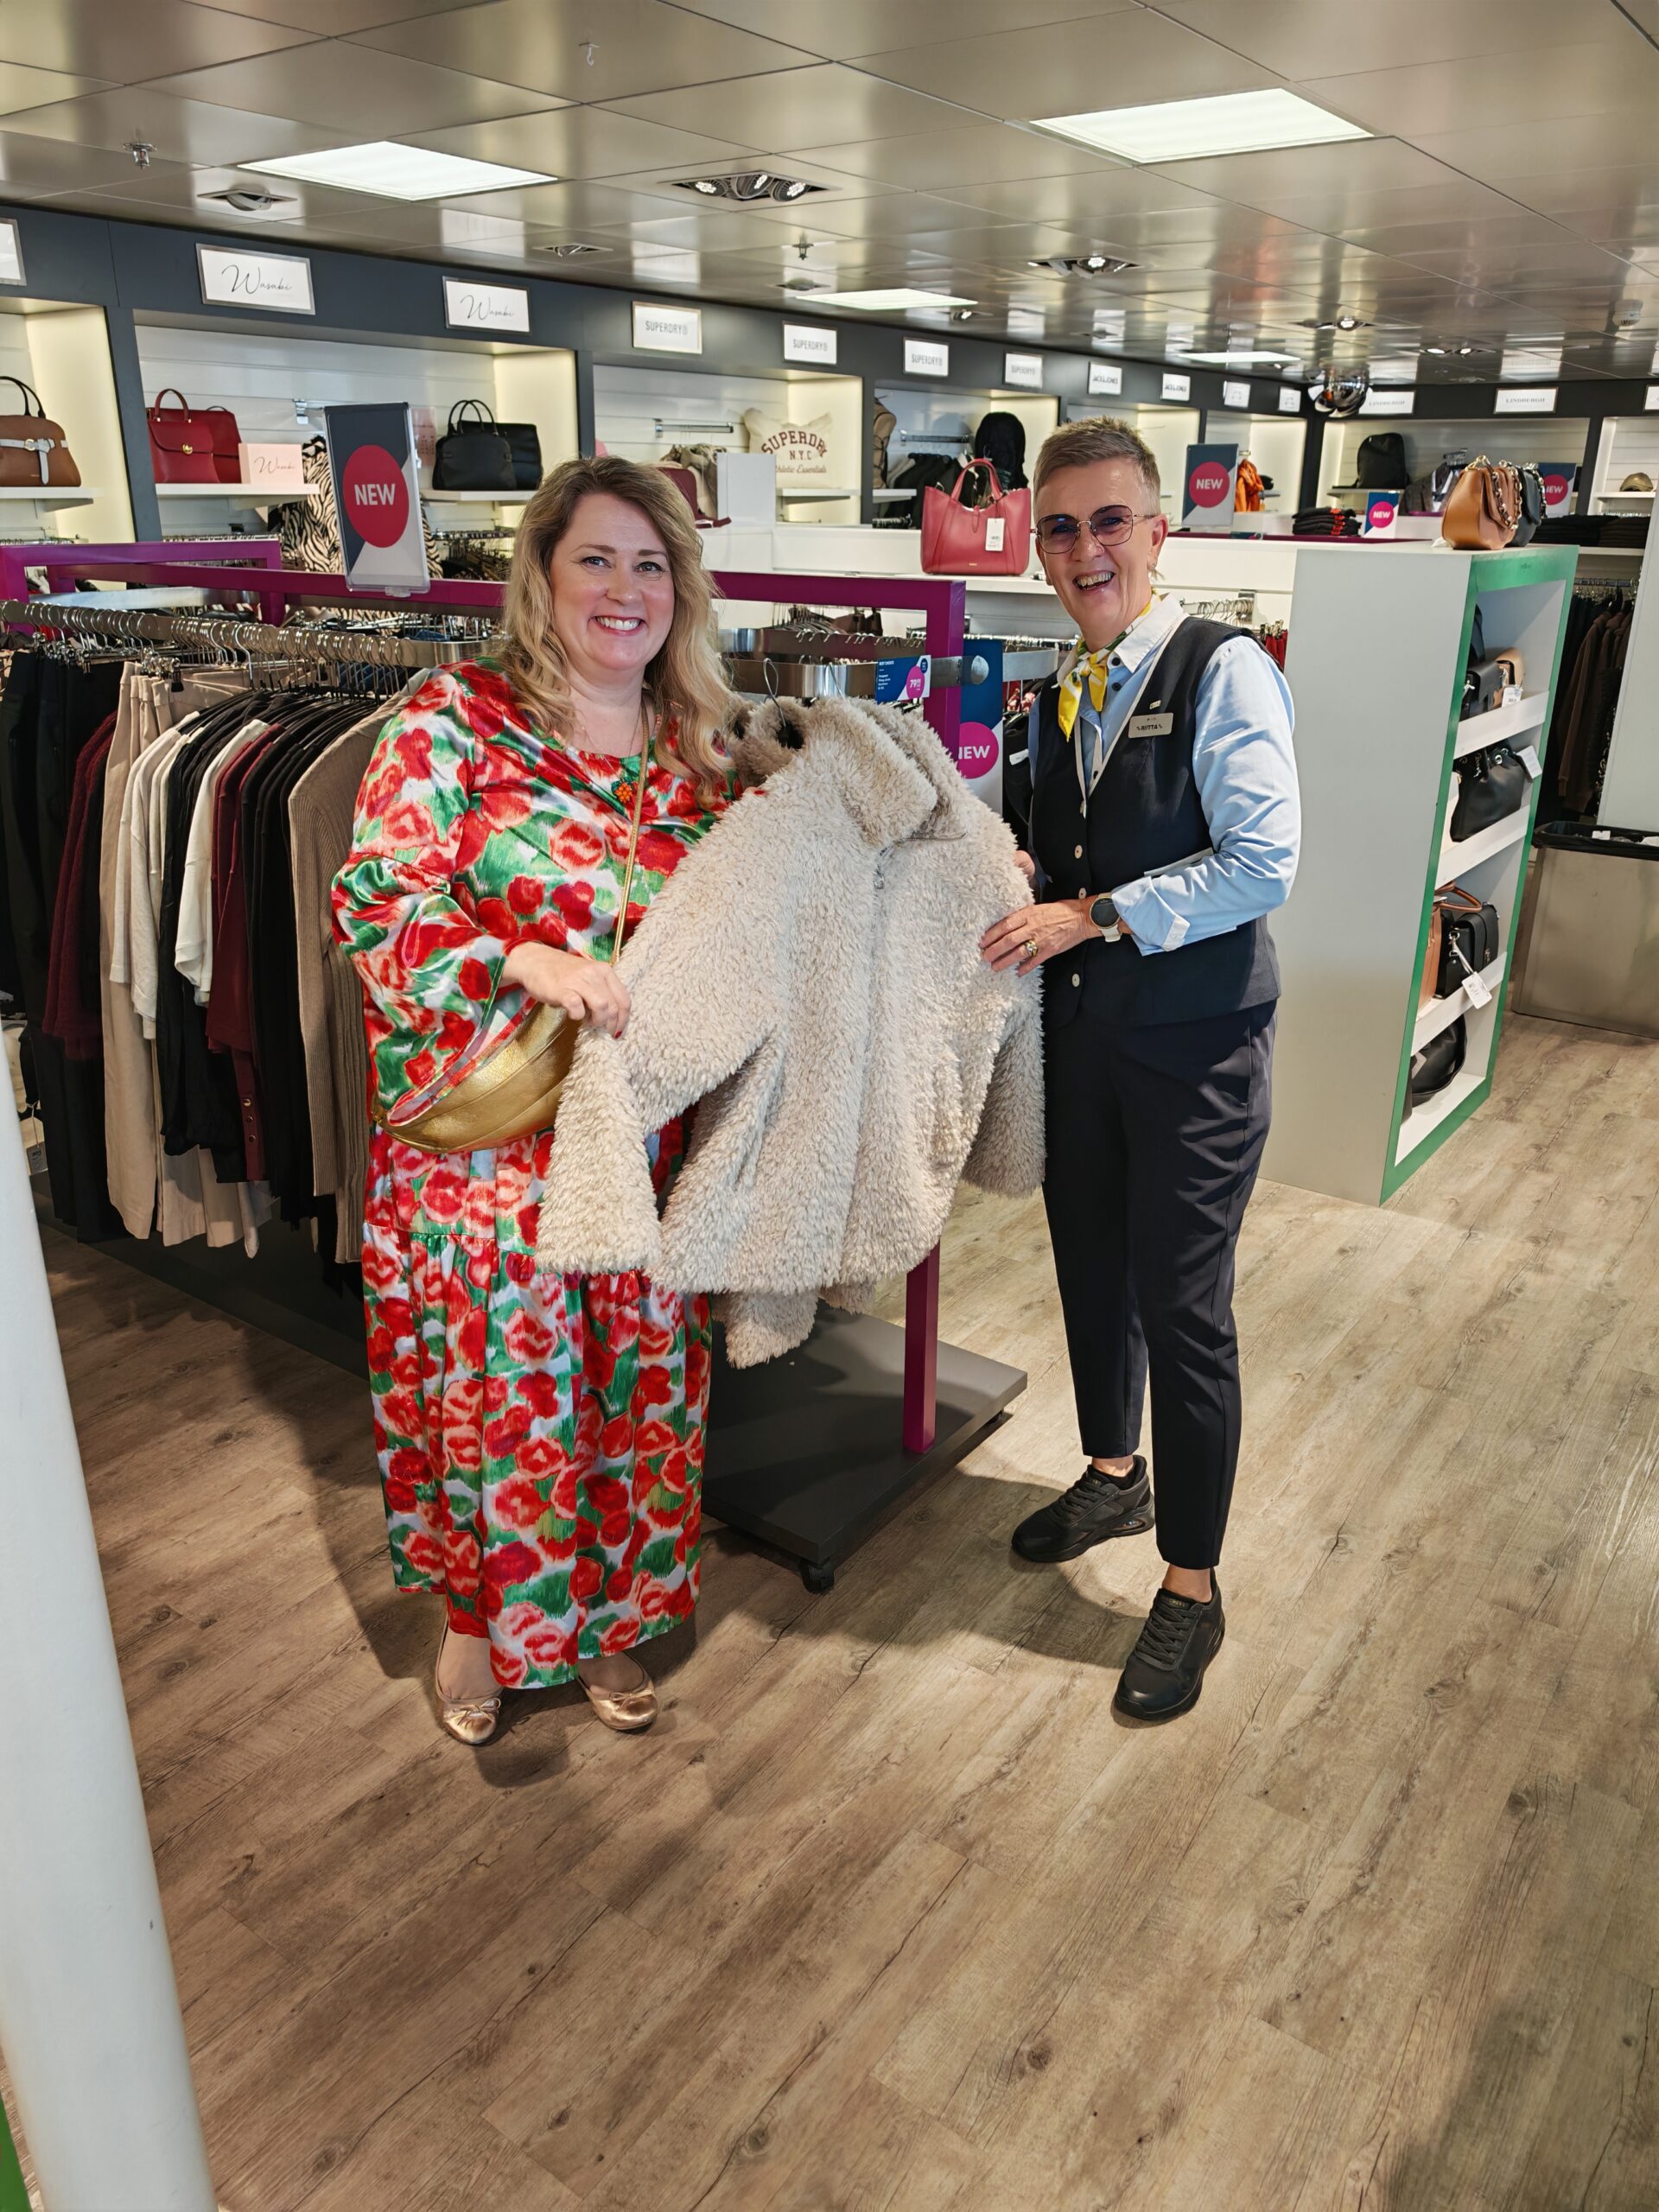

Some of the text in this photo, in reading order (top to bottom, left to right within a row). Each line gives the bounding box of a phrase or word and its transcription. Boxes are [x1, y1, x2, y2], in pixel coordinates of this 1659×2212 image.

[221, 264, 292, 295] Wasabi
[460, 294, 514, 321] Wasabi
[353, 483, 396, 506] NEW
[1196, 478, 1224, 489] NEW
